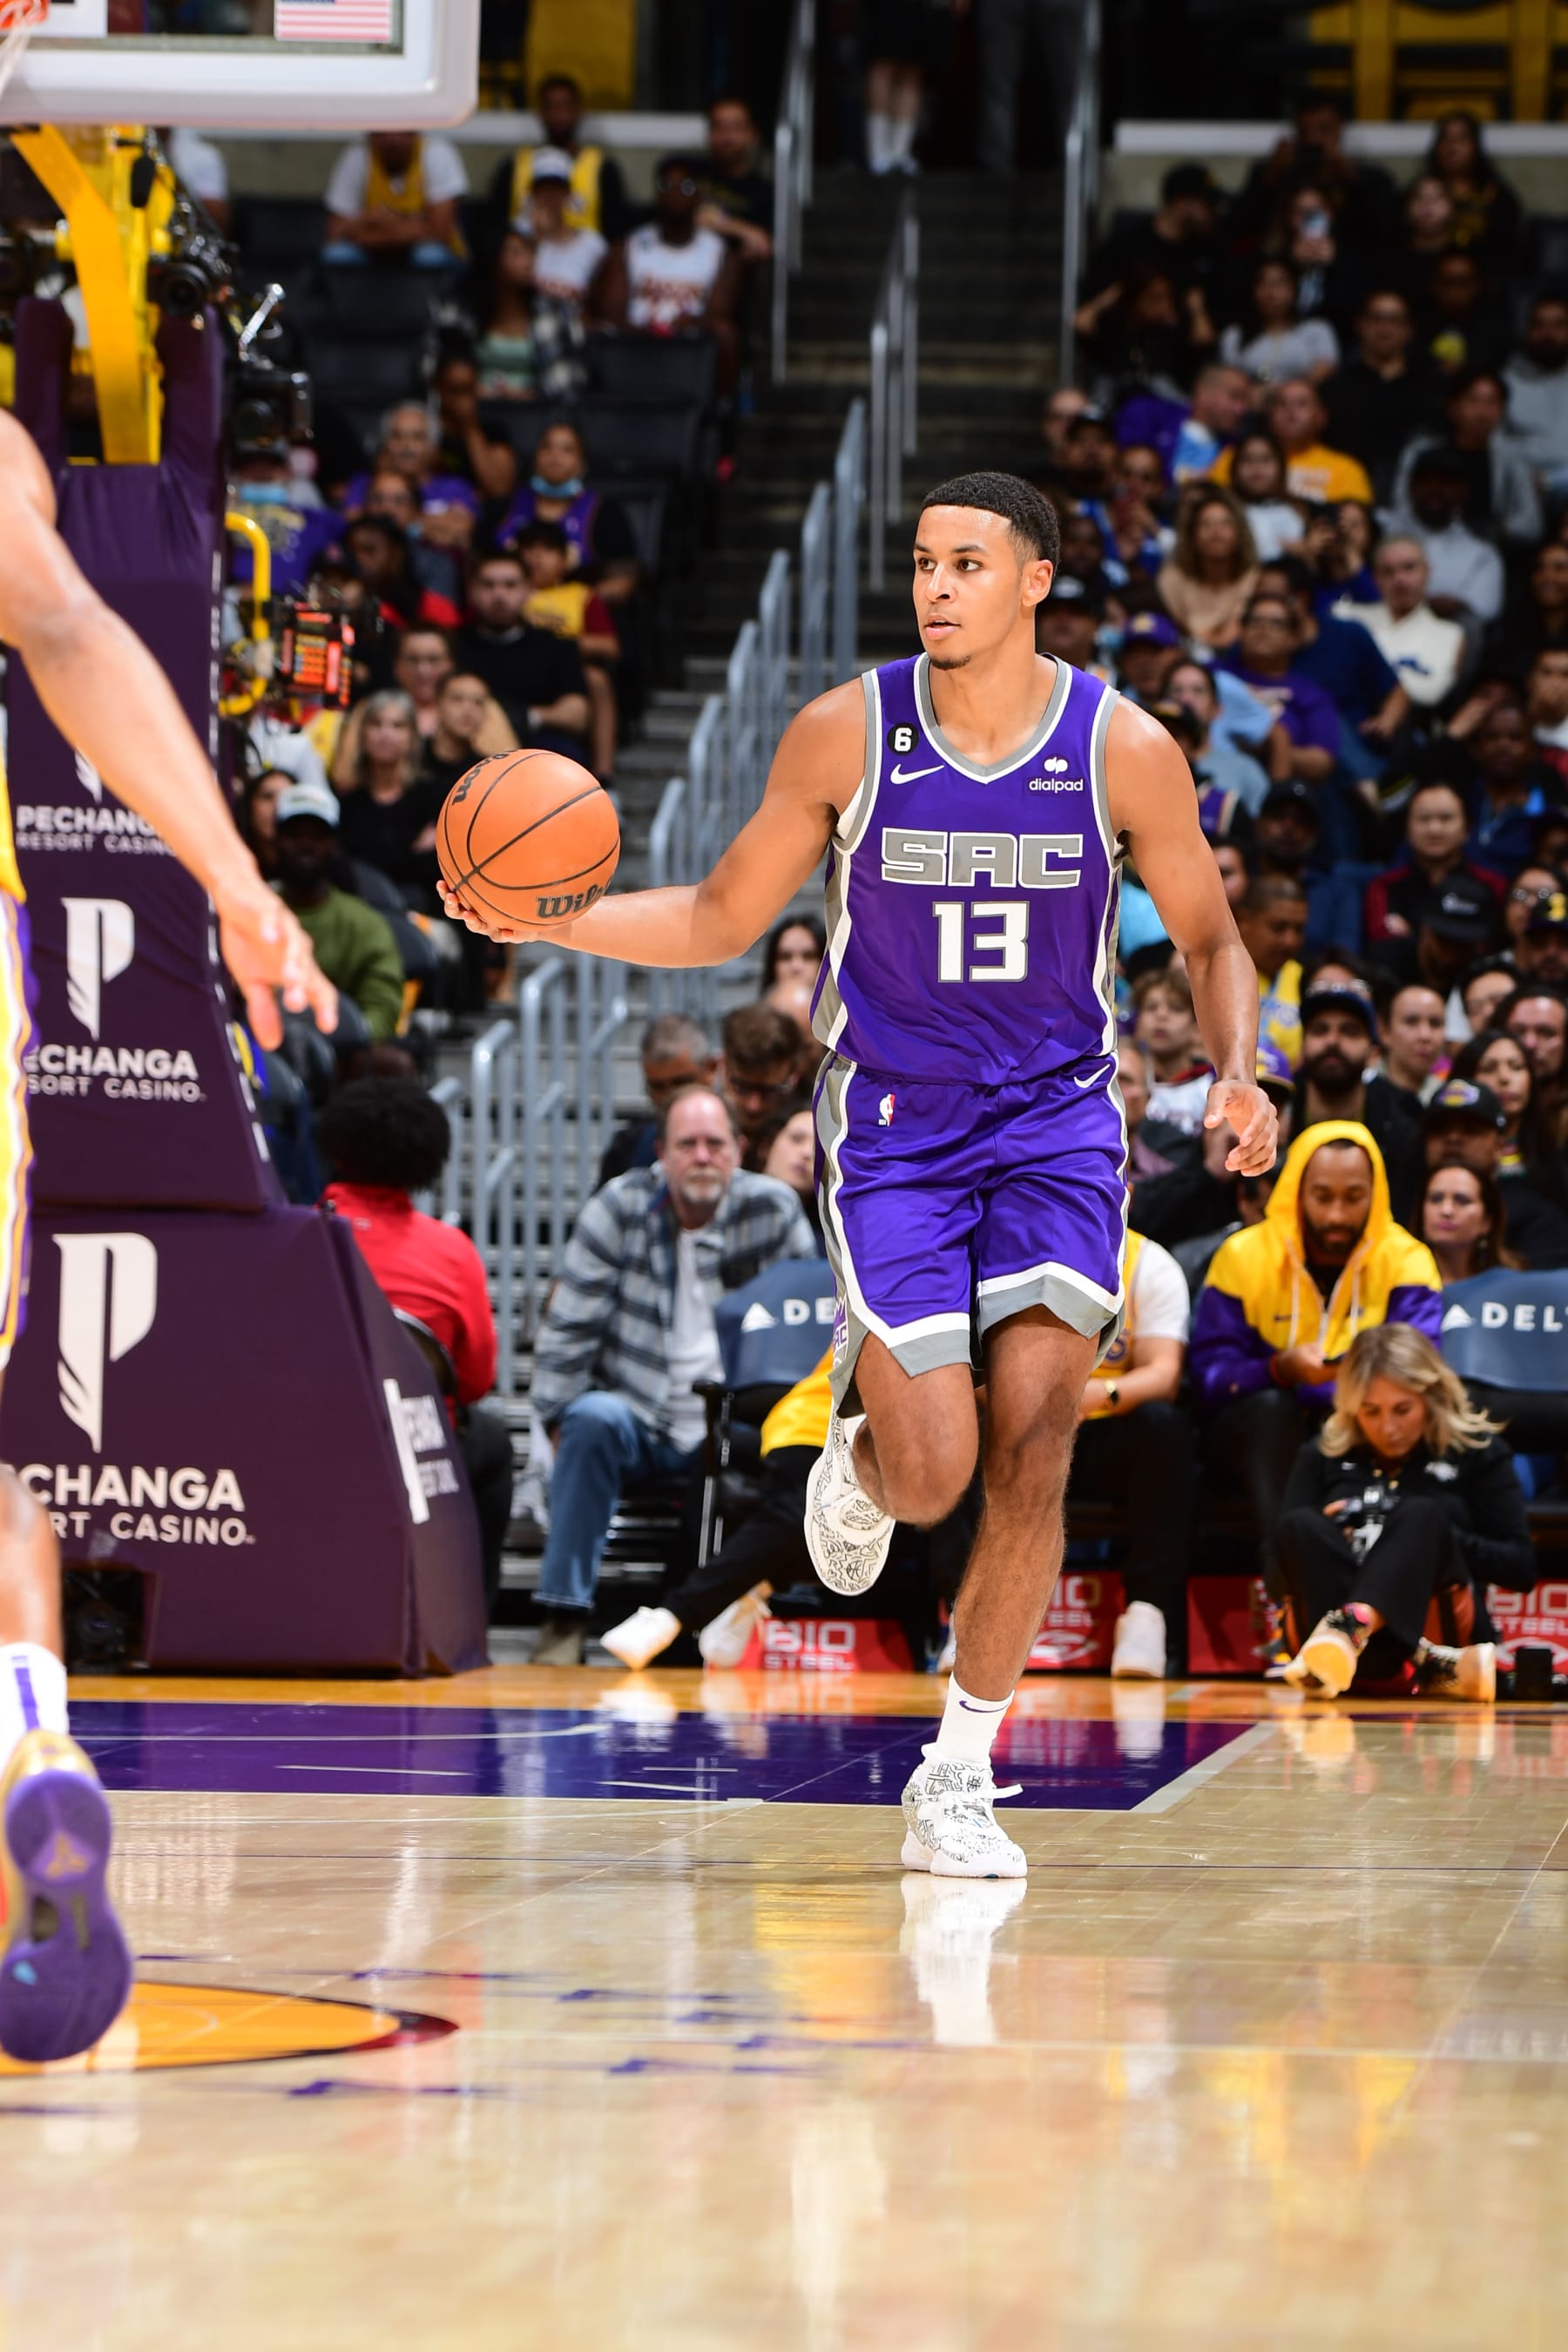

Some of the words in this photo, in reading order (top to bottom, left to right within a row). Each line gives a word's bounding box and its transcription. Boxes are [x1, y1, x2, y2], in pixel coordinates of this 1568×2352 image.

[894, 727, 912, 753] 6
[1029, 778, 1084, 794] dialpad
[16, 805, 159, 836] PECHAN
[16, 831, 95, 852] RESORT
[103, 834, 178, 857] CASIN
[881, 827, 1084, 889] SAC
[932, 900, 1031, 983] 13
[23, 1044, 199, 1081] CHANGA
[27, 1074, 92, 1098] SORT
[104, 1077, 201, 1104] CASINO
[1482, 1301, 1568, 1333] DEL
[17, 1463, 246, 1512] CHANGA
[110, 1511, 247, 1547] CASINO
[766, 1620, 855, 1654] BIO
[764, 1653, 855, 1671] STEEL
